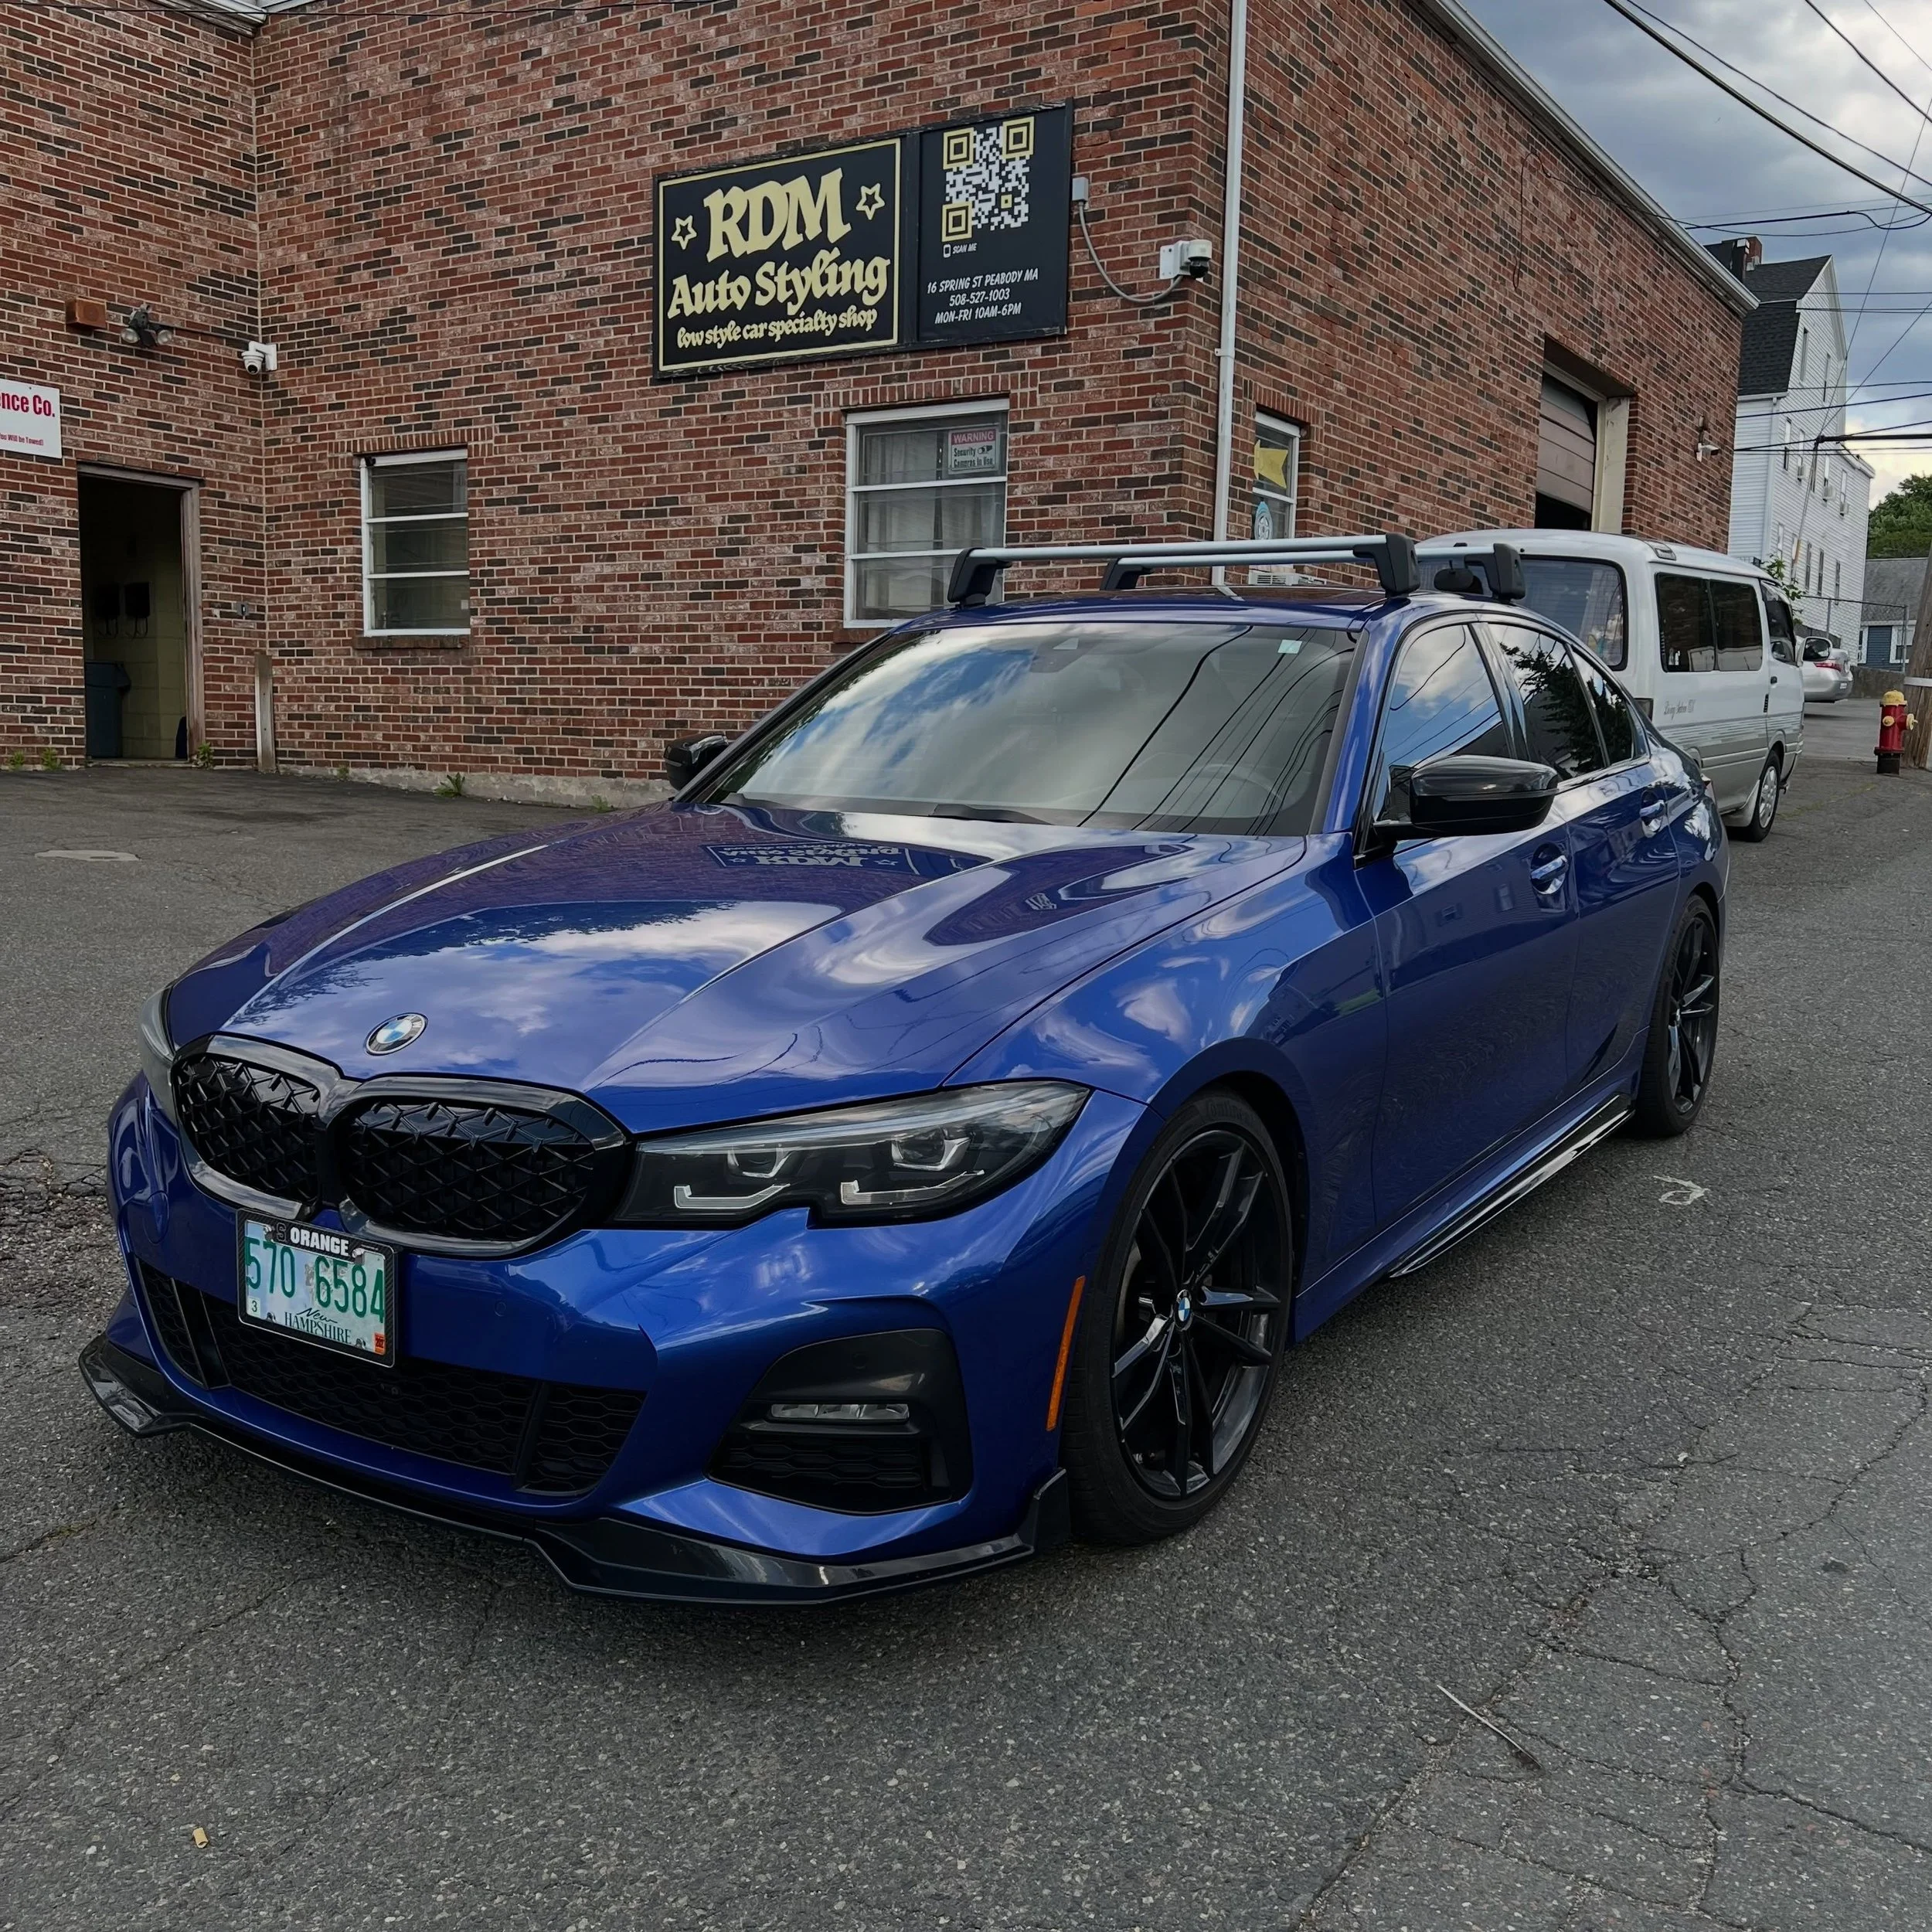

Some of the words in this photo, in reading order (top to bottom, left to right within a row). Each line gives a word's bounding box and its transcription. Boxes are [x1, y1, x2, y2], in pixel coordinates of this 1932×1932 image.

[703, 168, 852, 263] RDM
[952, 243, 967, 254] SCAN
[968, 243, 978, 252] ME
[667, 270, 752, 319] Auto
[755, 247, 891, 315] Styling
[927, 281, 937, 294] 16
[939, 277, 971, 293] SPRING
[972, 275, 983, 288] ST
[985, 270, 1023, 287] PEABODY
[1024, 267, 1039, 281] MA
[949, 287, 1010, 307] 508-527-1003
[934, 308, 973, 324] MON-FRI
[975, 302, 1022, 320] 10AM-6PM
[677, 327, 704, 349] low
[706, 320, 742, 349] style
[743, 323, 768, 339] car
[768, 309, 838, 342] specialty
[838, 305, 878, 332] shop
[0, 393, 29, 413] nce
[32, 394, 55, 417] Co.
[954, 430, 994, 444] WARNING
[954, 447, 976, 457] Security
[954, 459, 976, 468] Cameras
[983, 456, 993, 466] Use
[290, 1227, 349, 1257] ORANGE
[244, 1236, 295, 1298] 570
[315, 1255, 385, 1324] 6584
[251, 1300, 257, 1312] 3
[296, 1307, 338, 1324] New
[284, 1311, 352, 1345] HAMPSHIRE
